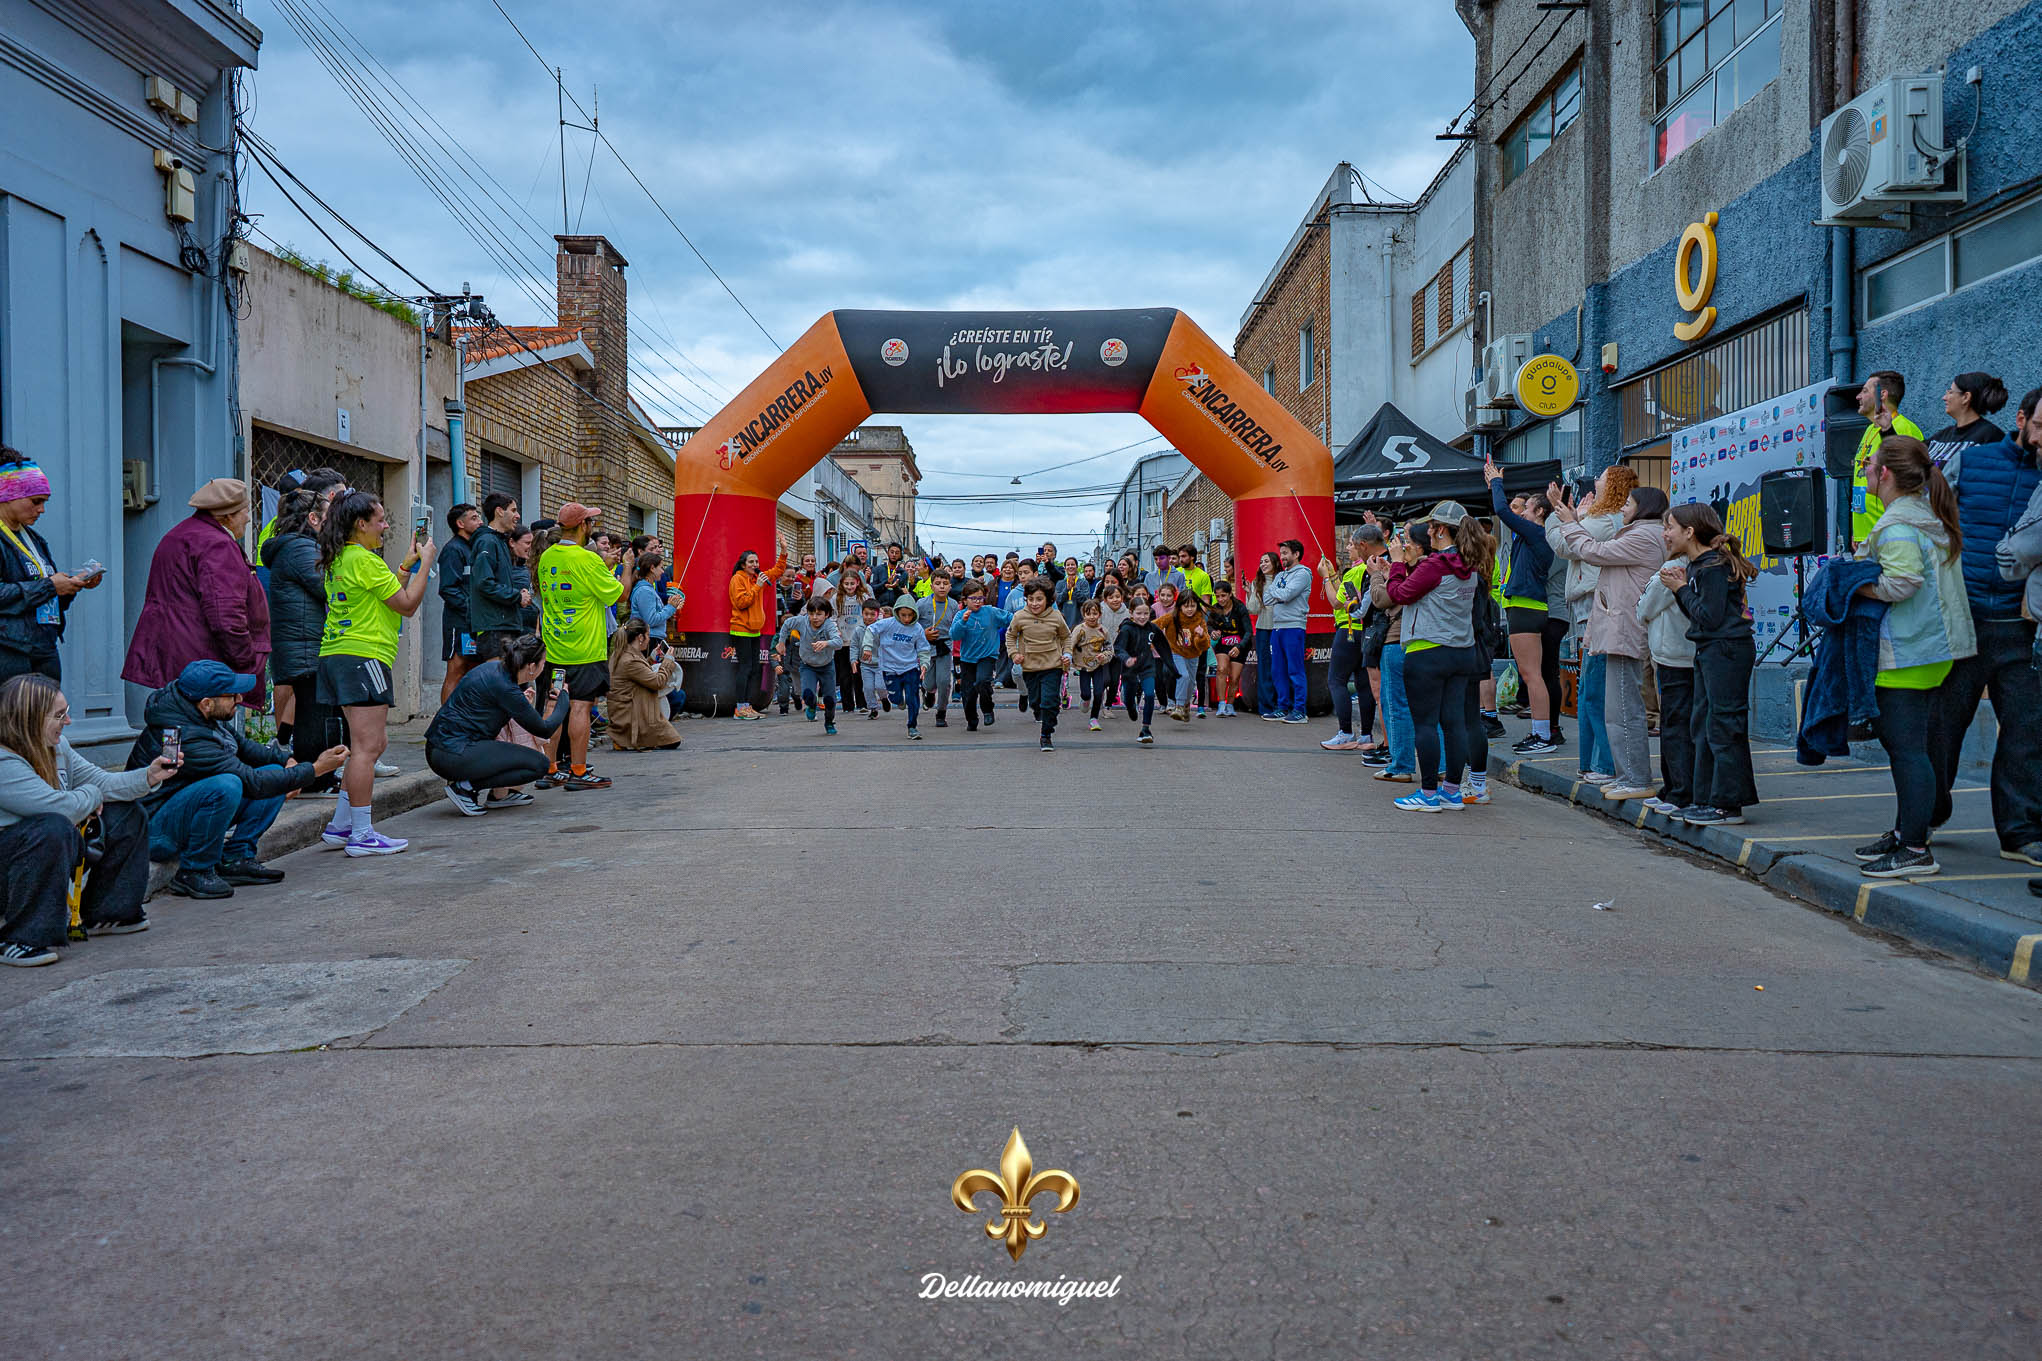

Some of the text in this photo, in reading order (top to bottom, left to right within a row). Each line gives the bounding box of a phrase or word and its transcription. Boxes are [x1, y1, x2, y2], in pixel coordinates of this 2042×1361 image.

[949, 327, 1053, 346] ¿CREÍSTE EN TÍ?
[975, 341, 1074, 383] lograste!
[1526, 360, 1573, 381] guadalupe
[1181, 390, 1230, 435] CRONOMETRAMOS
[1538, 401, 1557, 409] club
[743, 422, 791, 465] CRONOMETRAMOS
[794, 388, 828, 420] DIFUNDIMOS
[674, 647, 709, 659] CARRERA.UY
